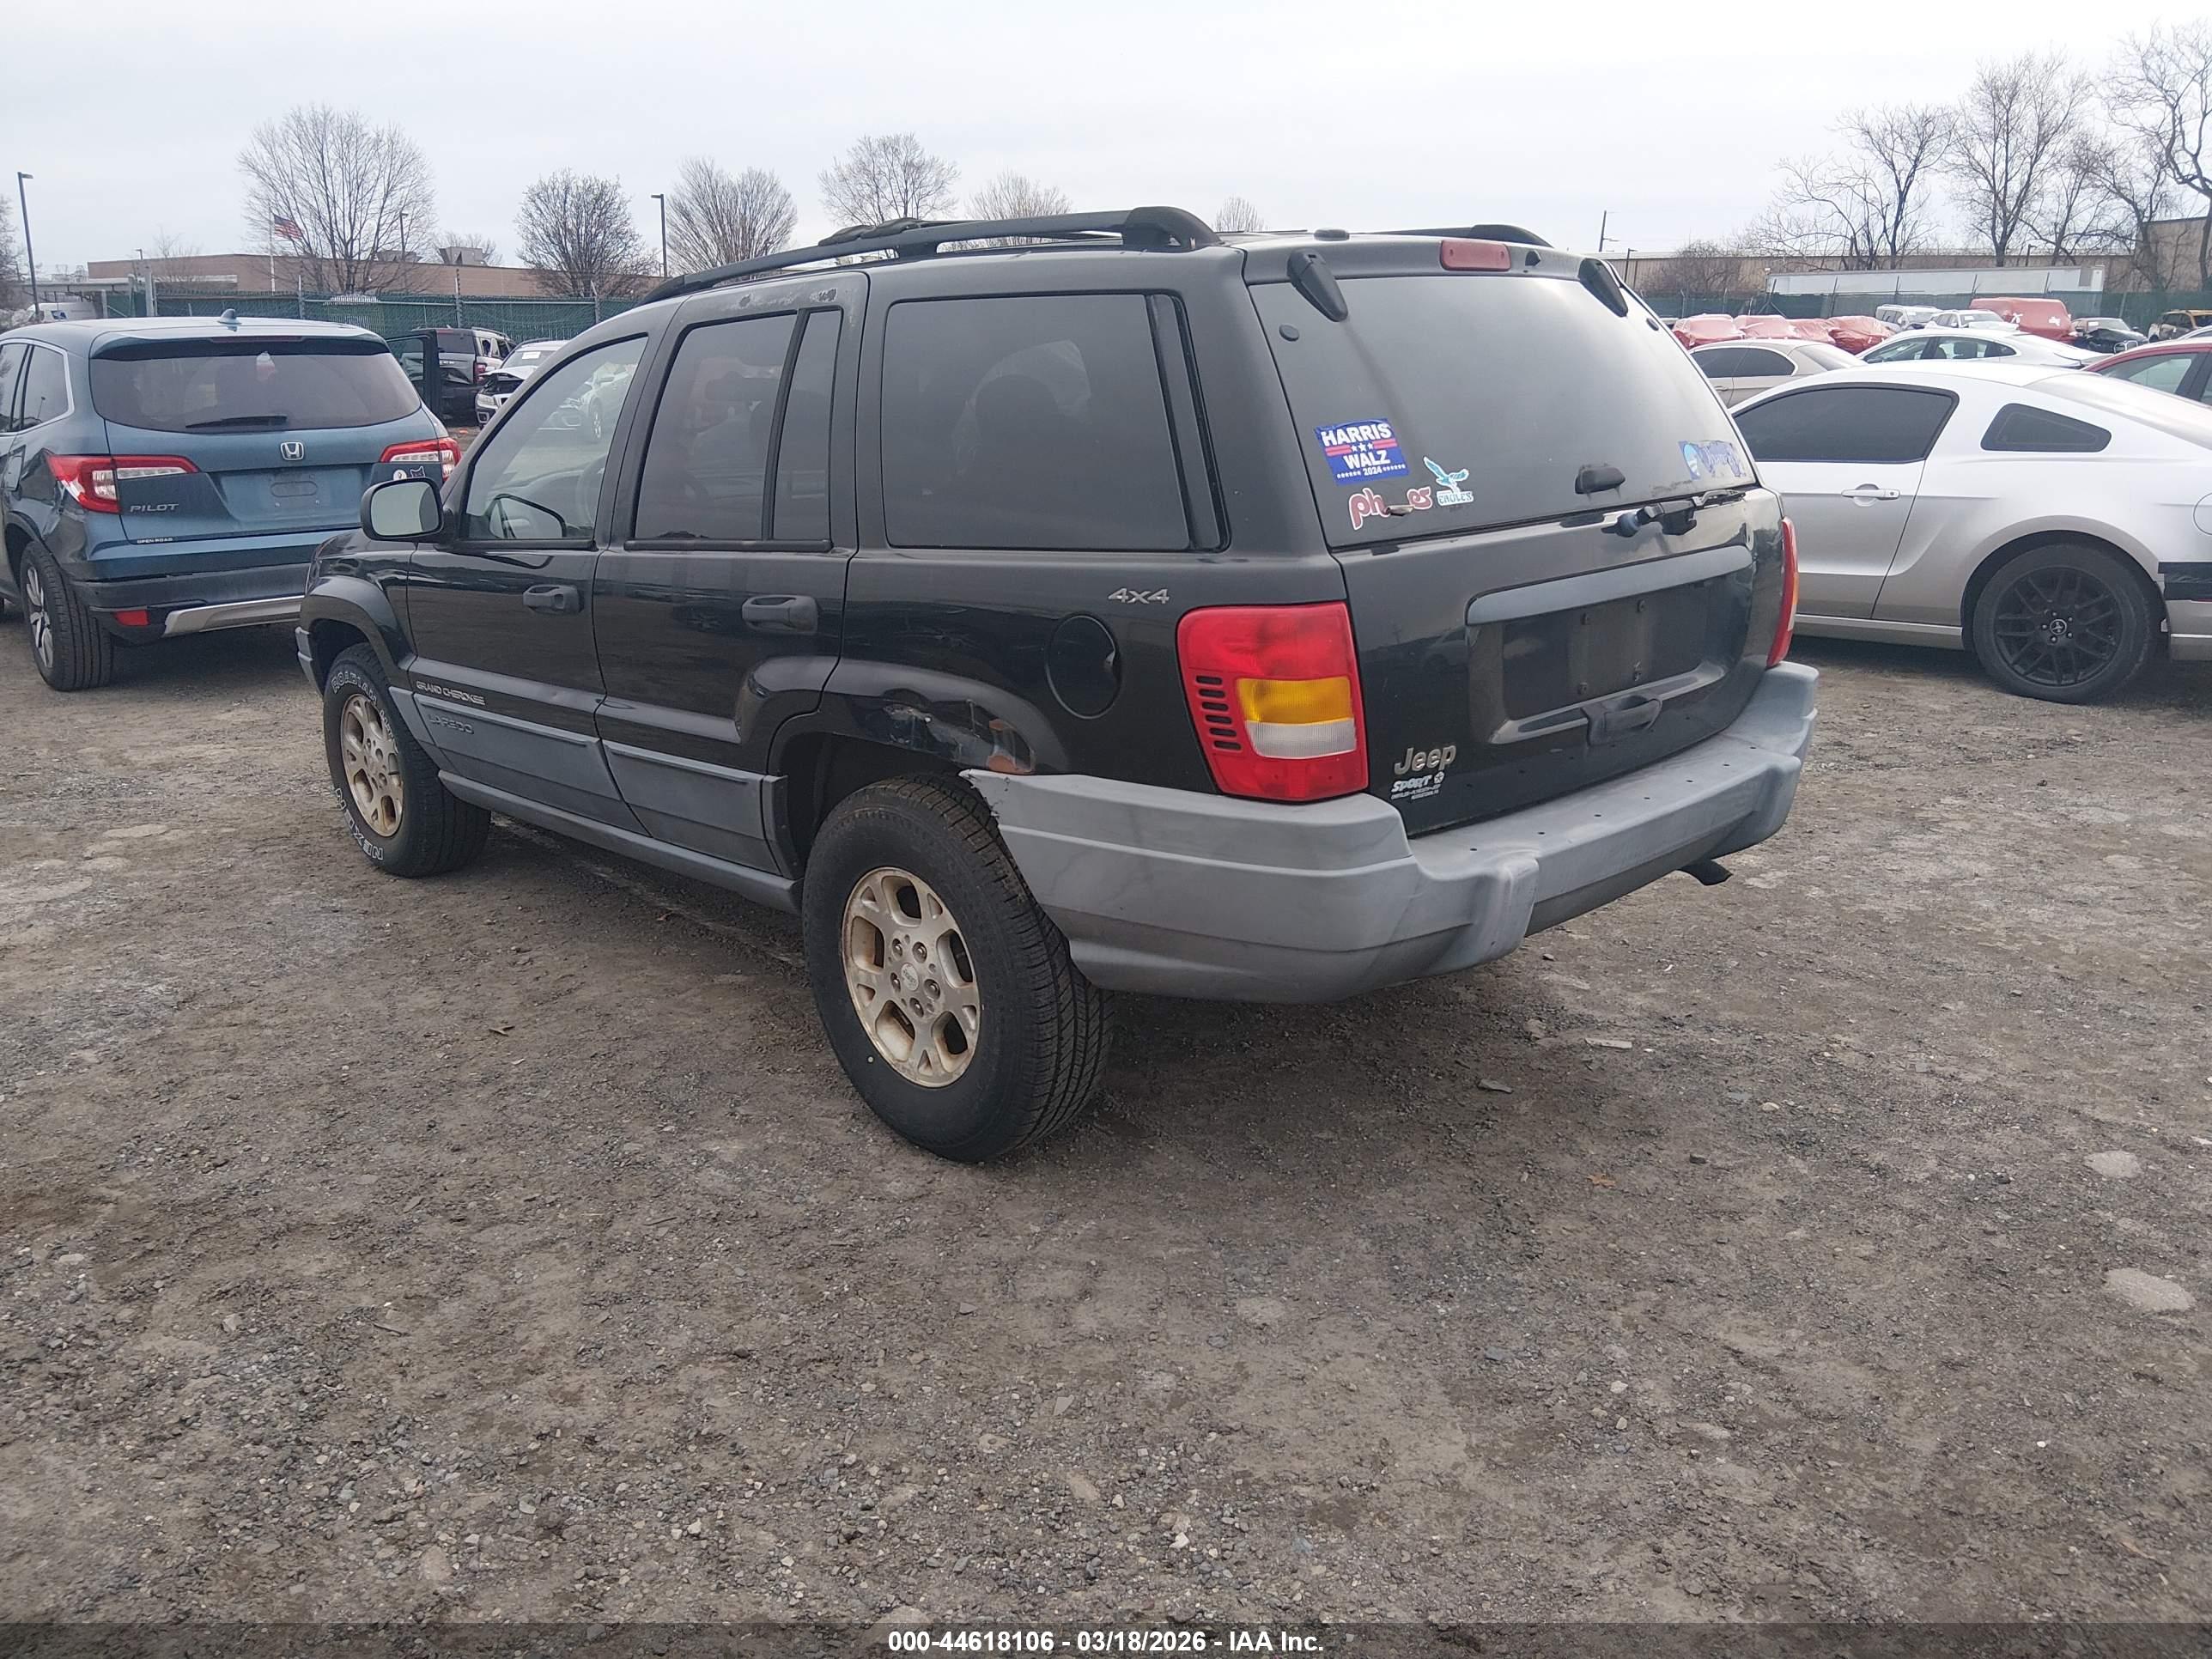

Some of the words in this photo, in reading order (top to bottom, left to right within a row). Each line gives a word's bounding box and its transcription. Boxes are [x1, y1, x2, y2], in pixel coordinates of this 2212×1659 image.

[1320, 422, 1392, 447] HARRIS
[1343, 450, 1390, 470] WALZ
[1363, 465, 1382, 477] 2024
[130, 503, 179, 513] PILOT
[416, 680, 442, 695] GRAND
[442, 687, 486, 706] CHEROKEE
[1394, 745, 1456, 775] Jeep
[1391, 775, 1432, 793] SPORT
